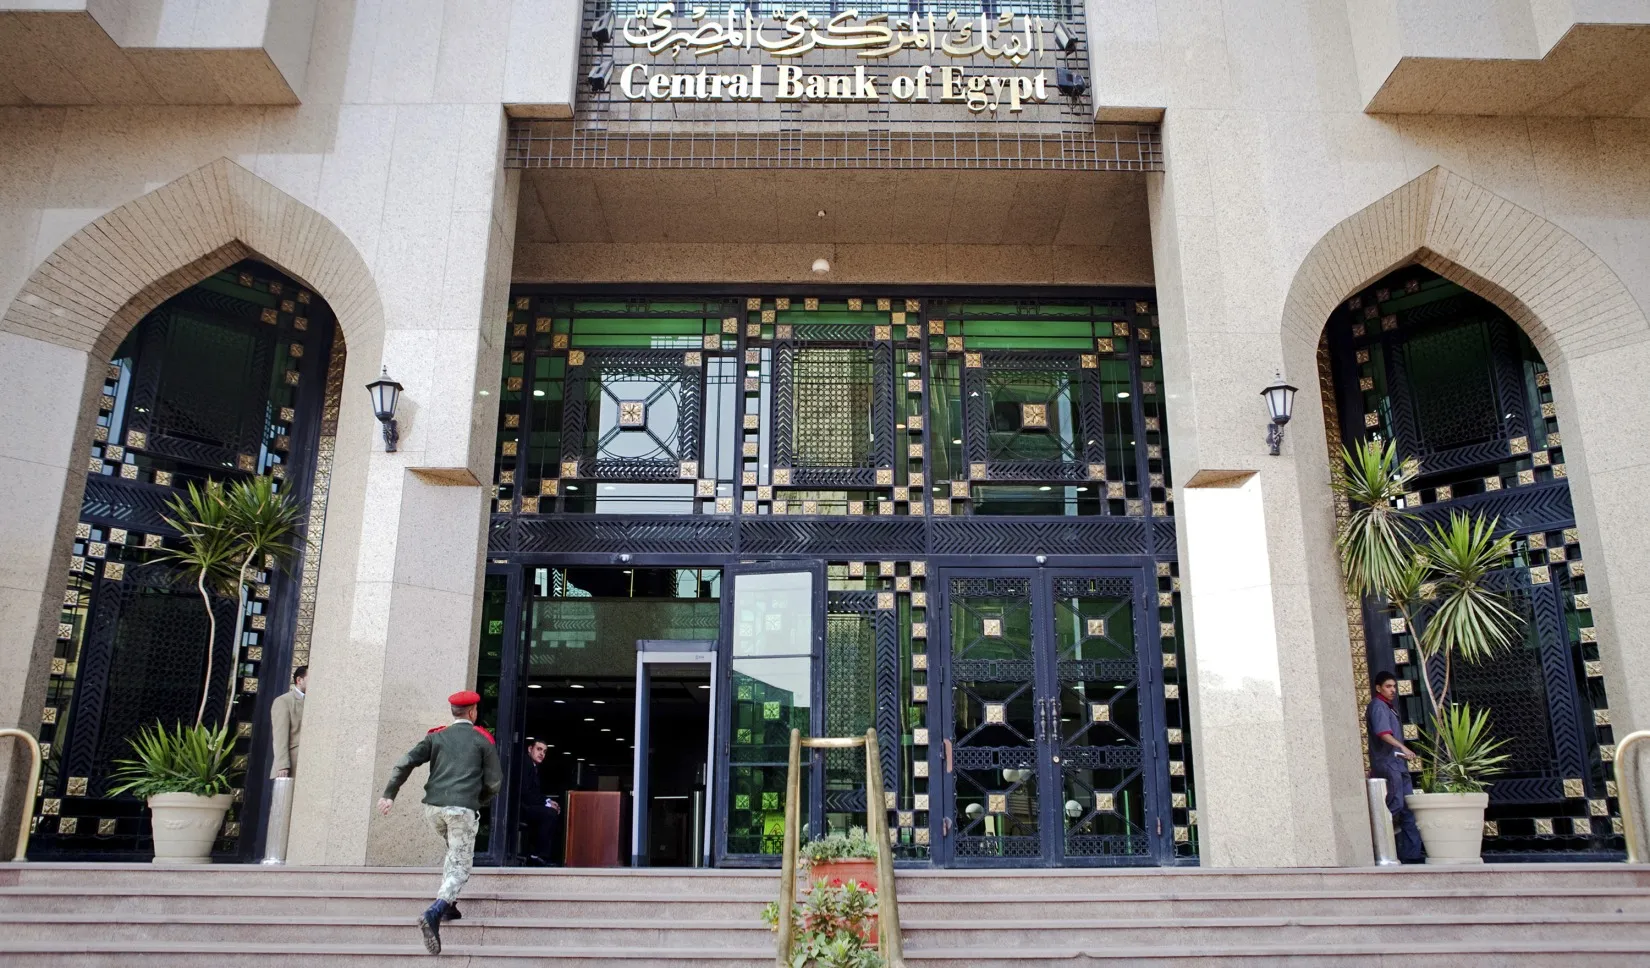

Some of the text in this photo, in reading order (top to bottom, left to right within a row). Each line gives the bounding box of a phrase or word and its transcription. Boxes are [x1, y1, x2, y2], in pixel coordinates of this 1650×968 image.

[620, 63, 1049, 113] Central Bank of Egypt
